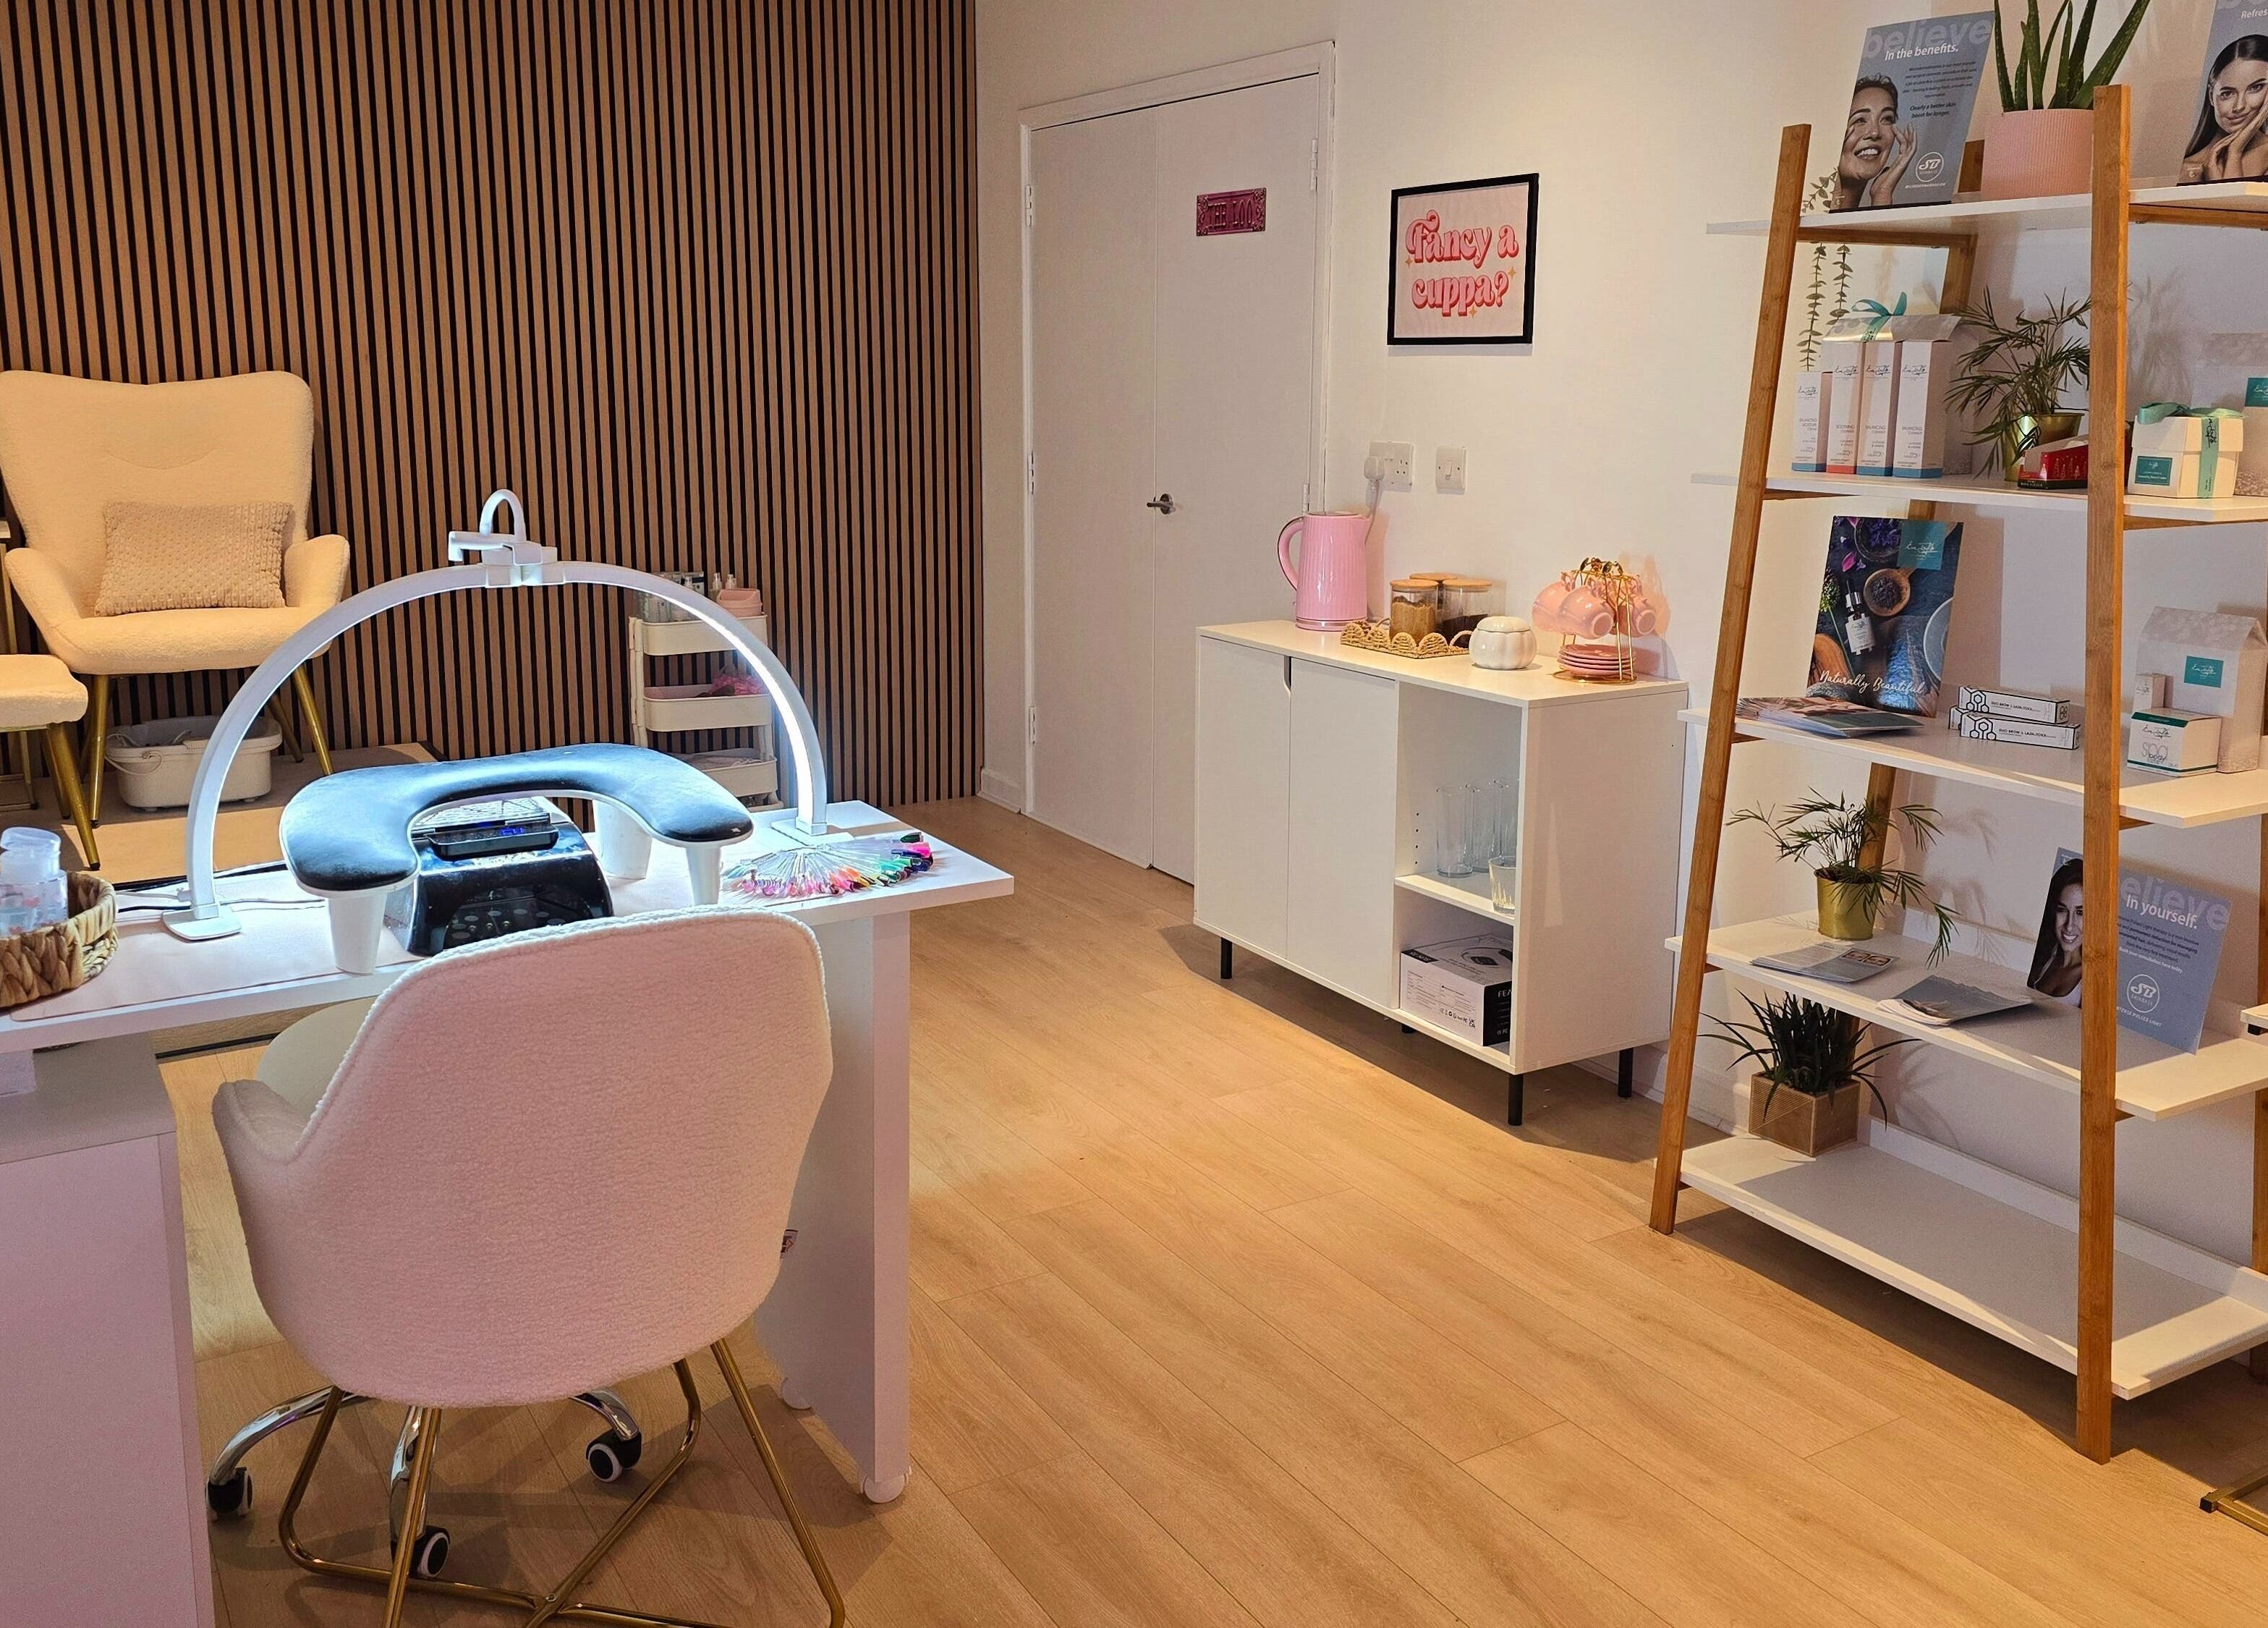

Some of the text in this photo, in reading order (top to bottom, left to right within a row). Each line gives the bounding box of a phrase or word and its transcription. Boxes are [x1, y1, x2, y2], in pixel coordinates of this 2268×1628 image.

[1885, 42, 1959, 61] In the benefits.
[1207, 200, 1253, 227] THE LOO
[1406, 209, 1519, 268] Fancy a
[1411, 270, 1509, 317] cuppa?
[1820, 670, 1925, 694] Naturally Beautiful
[2120, 875, 2229, 931] elieve
[2126, 894, 2198, 930] In yourself.
